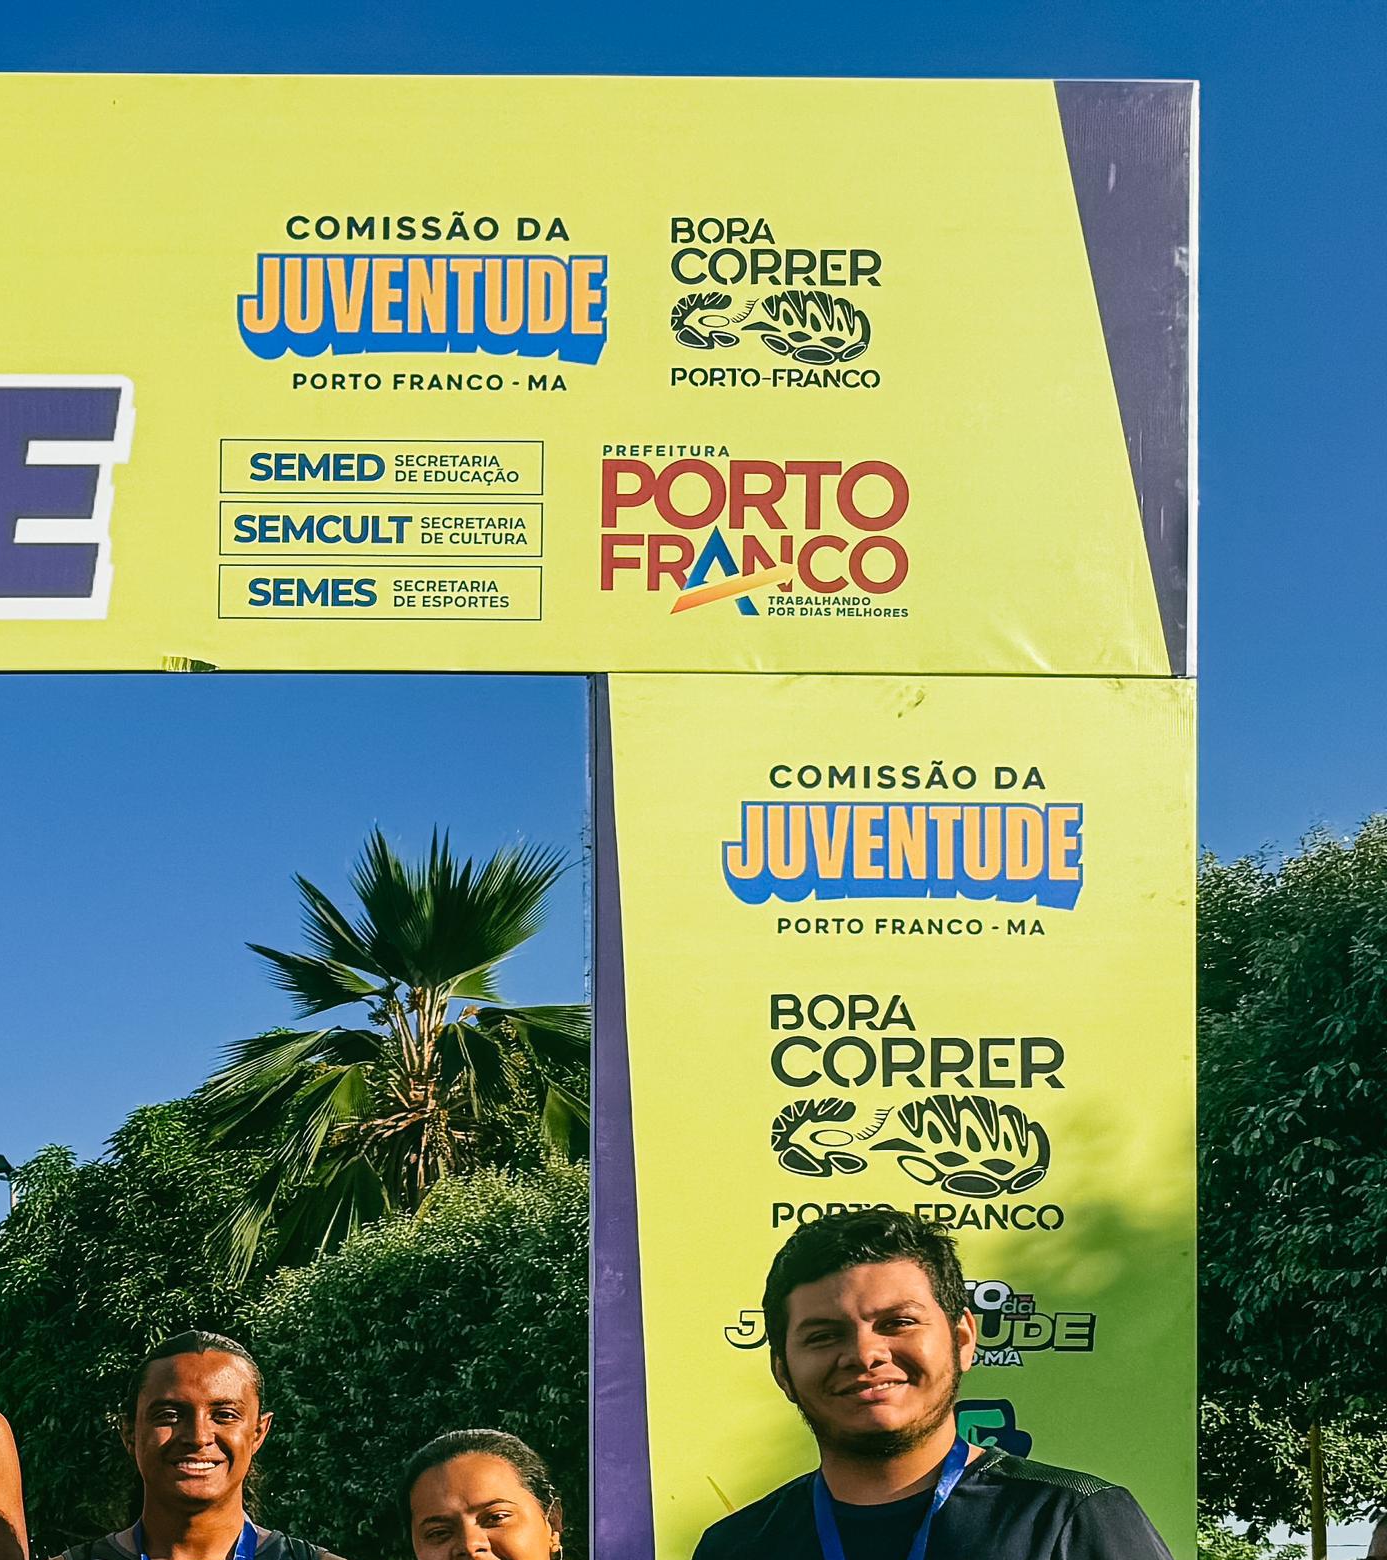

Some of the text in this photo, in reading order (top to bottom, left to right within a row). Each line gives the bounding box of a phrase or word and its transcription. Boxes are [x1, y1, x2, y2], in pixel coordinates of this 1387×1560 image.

[286, 211, 570, 242] COMISSÃO DA
[671, 217, 776, 245] BORA
[671, 248, 882, 287] CORRER
[239, 254, 608, 350] JUVENTUDE
[292, 372, 383, 392] PORTO
[391, 373, 506, 392] FRANCO
[528, 373, 568, 392] MA
[671, 366, 882, 389] PORTO-FRANCO
[603, 445, 730, 458] PREFEITURA
[249, 452, 501, 482] SEMED SECRETARIA
[394, 466, 520, 486] DE EDUCAÇÃO
[601, 459, 910, 532] PORTO
[233, 514, 527, 545] SEMCULT SECRETARIA
[421, 531, 528, 545] DE CULTURA
[600, 530, 910, 602] FRANCO
[248, 578, 499, 607] SEMES SECRETARIA
[393, 594, 510, 609] DE ESPORTES
[768, 596, 871, 606] TRABALHANDO
[768, 607, 910, 618] POR DIAS MELHORES
[769, 761, 1046, 790] COMISSÃO DA
[723, 802, 1082, 897] JUVENTUDE
[777, 918, 864, 935] PORTO
[875, 918, 983, 935] FRANCO
[1007, 918, 1046, 935] MA
[770, 994, 916, 1032] BORA
[770, 1037, 1066, 1089] CORRER
